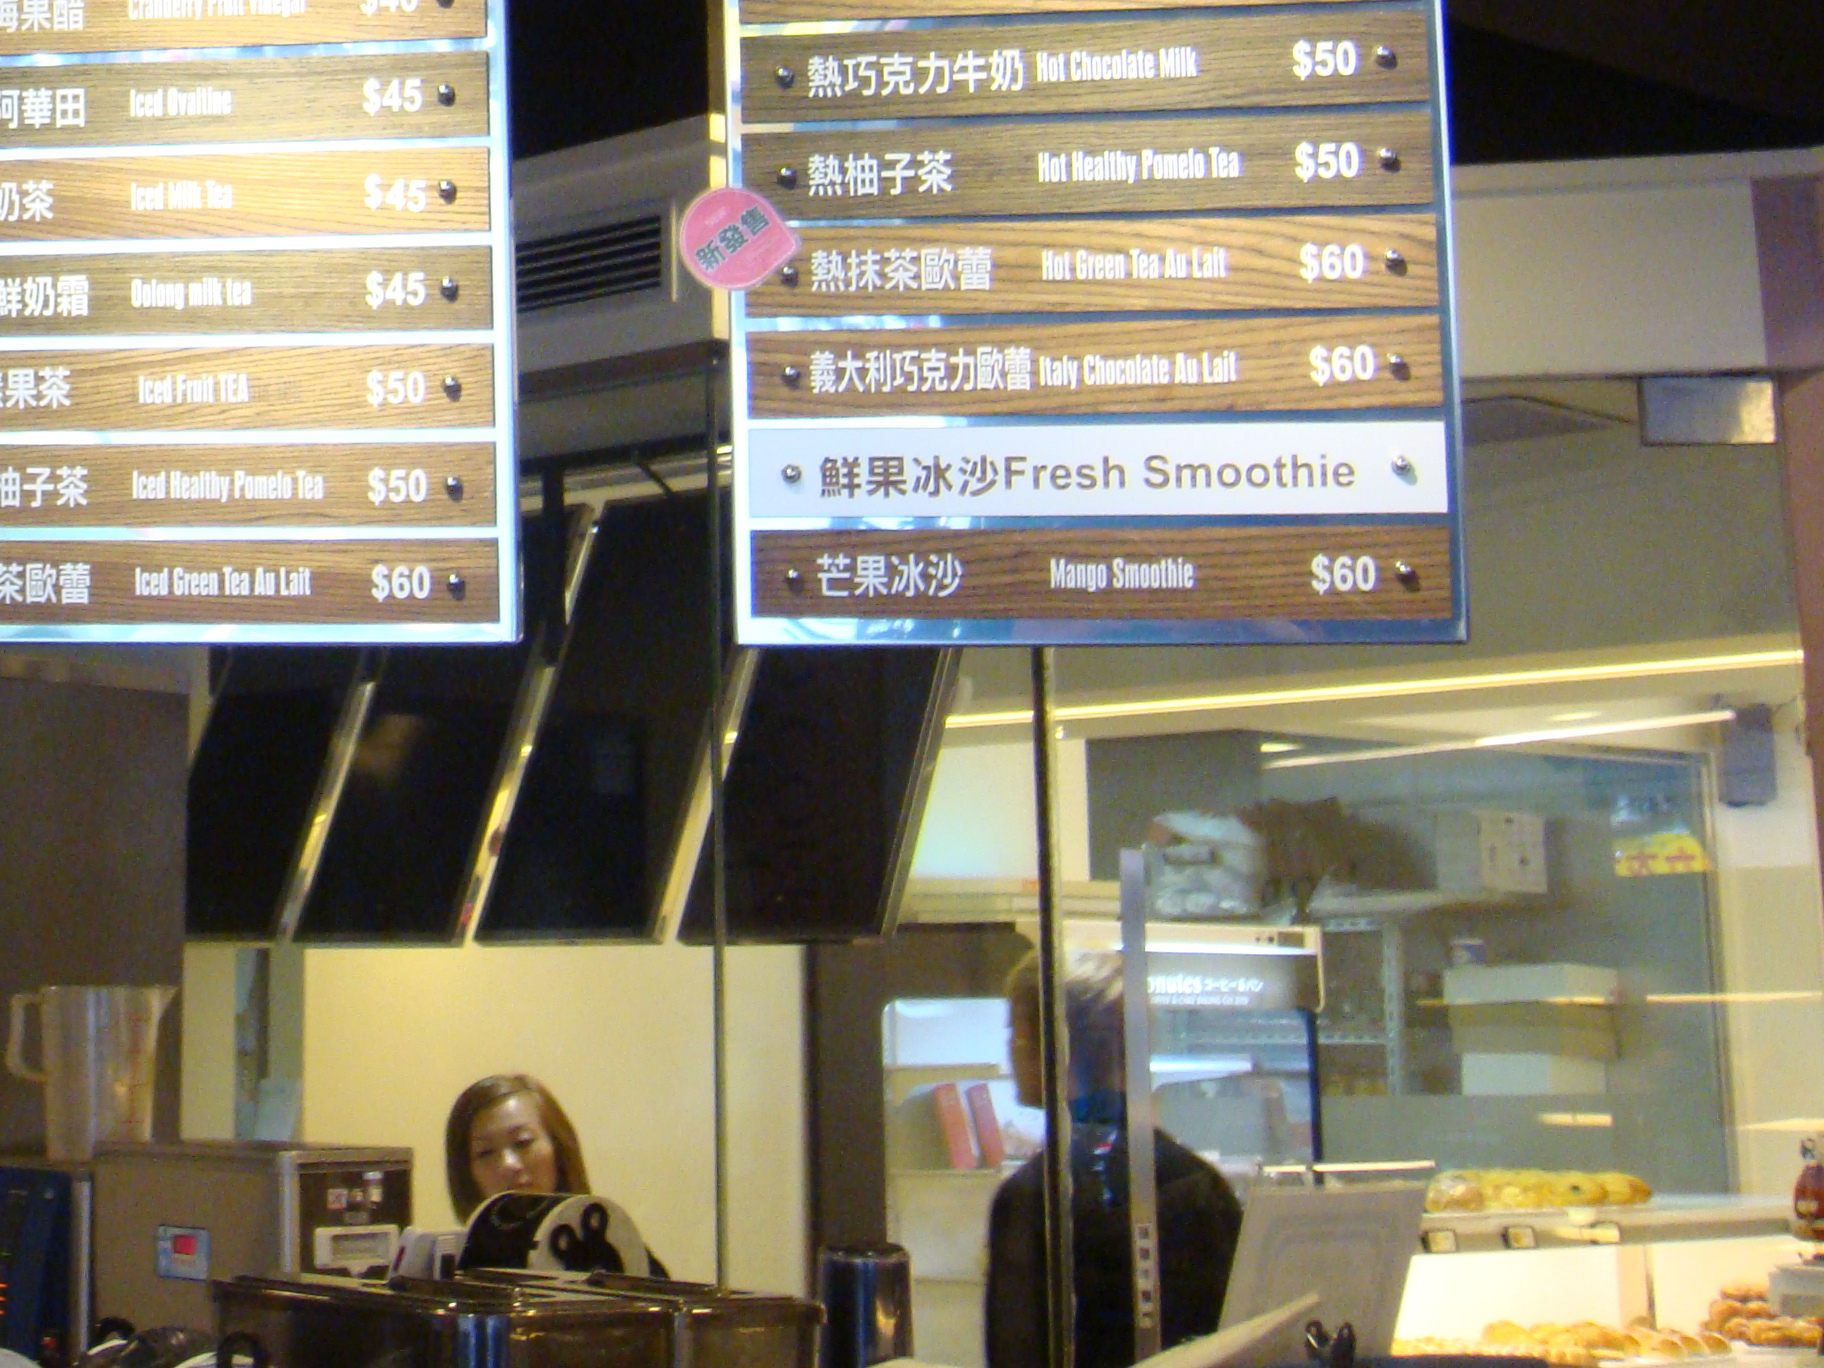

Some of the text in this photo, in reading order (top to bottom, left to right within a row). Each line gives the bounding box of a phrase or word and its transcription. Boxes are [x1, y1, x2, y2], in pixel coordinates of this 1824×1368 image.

[809, 40, 1356, 97] 熱巧克力牛奶 Hot Chocolate Milk $50
[131, 88, 165, 117] Iced
[363, 78, 423, 116] $45
[809, 141, 1359, 196] 熱柚子茶 Hot Healthy Pomelo Tea $50
[205, 180, 234, 208] Tea
[365, 173, 428, 212] $45
[1043, 243, 1365, 282] Hot Green Tea Au Lait $60
[366, 271, 427, 309] $45
[1040, 345, 1377, 389] Italy Chocolate Au Lait $60
[139, 375, 175, 404] Iced
[177, 375, 215, 403] Fruit
[219, 373, 249, 402] TEA
[367, 370, 427, 407] $50
[133, 471, 168, 499] Iced
[170, 470, 231, 502] Healthy
[235, 470, 294, 499] Pomelo
[297, 470, 326, 499] Tea
[369, 467, 428, 505] $50
[1144, 455, 1354, 489] Smoothie
[136, 568, 169, 595] Iced
[173, 567, 219, 595] Green
[223, 566, 250, 595] Tea
[255, 567, 275, 595] Au
[280, 567, 310, 595] Lait
[372, 564, 430, 602] $60
[817, 553, 1376, 596] 芒果冰沙 Mango Smoothie $60
